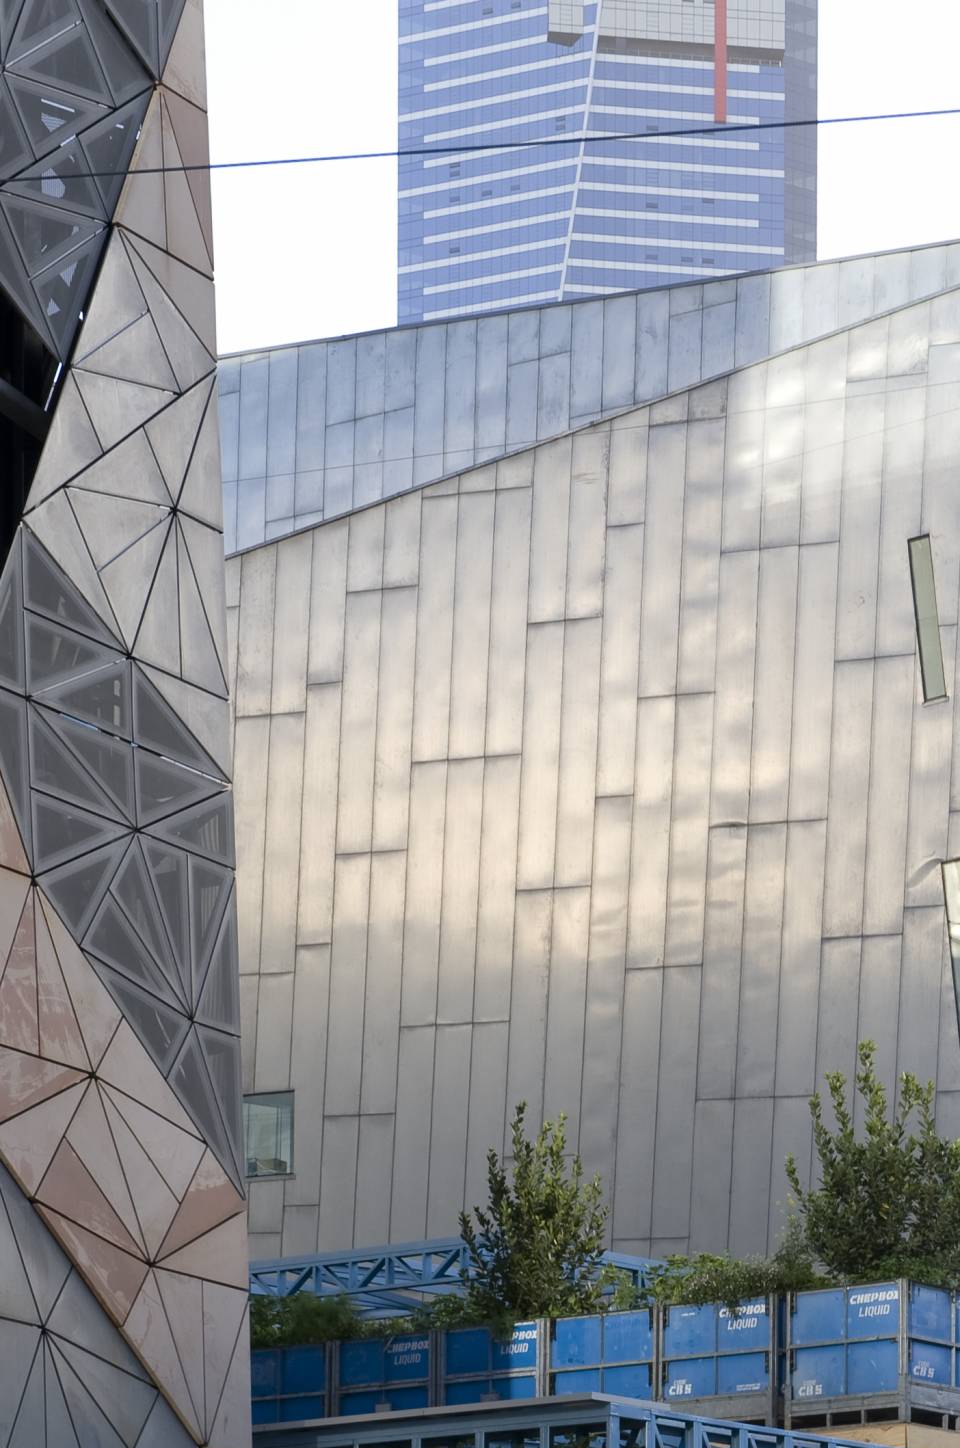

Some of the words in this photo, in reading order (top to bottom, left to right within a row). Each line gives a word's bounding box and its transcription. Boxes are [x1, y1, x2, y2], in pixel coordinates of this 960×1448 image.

[850, 1290, 898, 1305] CHEPBOX
[719, 1304, 766, 1318] CHPBOX
[858, 1304, 890, 1317] LIQUID
[727, 1318, 757, 1330] LIQUID
